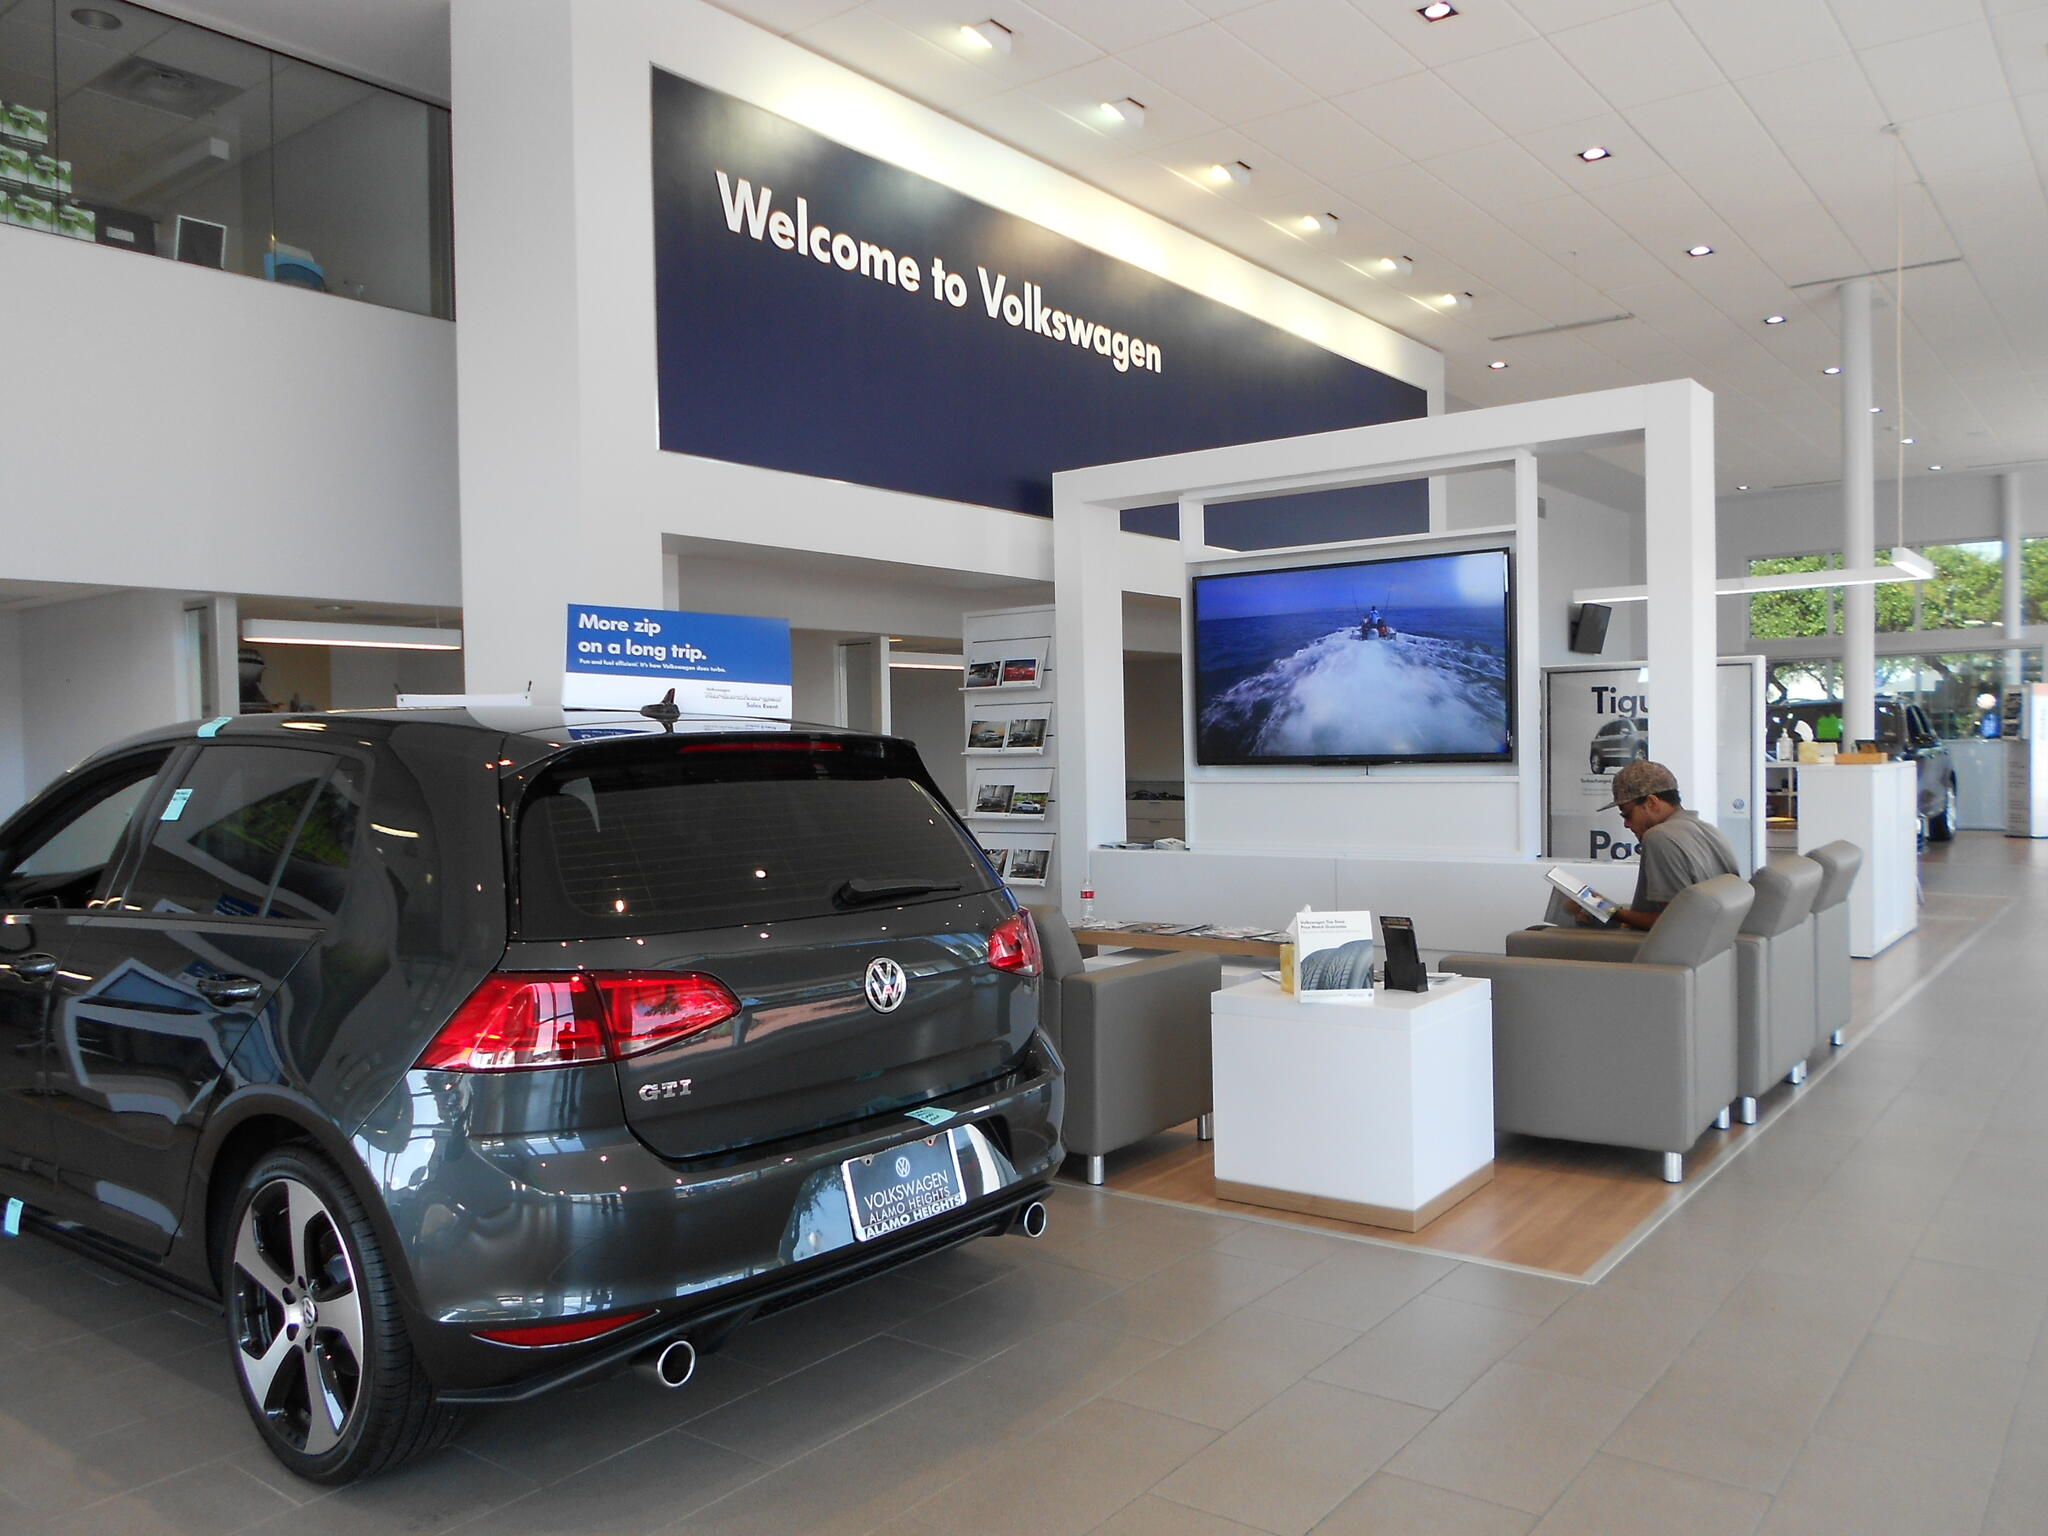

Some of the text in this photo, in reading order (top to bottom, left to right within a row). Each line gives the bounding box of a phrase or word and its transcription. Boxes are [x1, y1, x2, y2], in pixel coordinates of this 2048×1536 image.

[716, 169, 1162, 373] Welcome to Volkswagen
[578, 613, 661, 637] More zip
[578, 639, 707, 662] on a long trip.
[662, 663, 695, 671] Volkswagen
[1591, 686, 1648, 718] Tigu
[638, 1078, 692, 1101] GTI
[864, 1169, 949, 1210] VOLKSWAGEN
[869, 1186, 951, 1225] ALAMO HEIGHTS
[865, 1193, 961, 1238] ALAMO HEIGHTS
